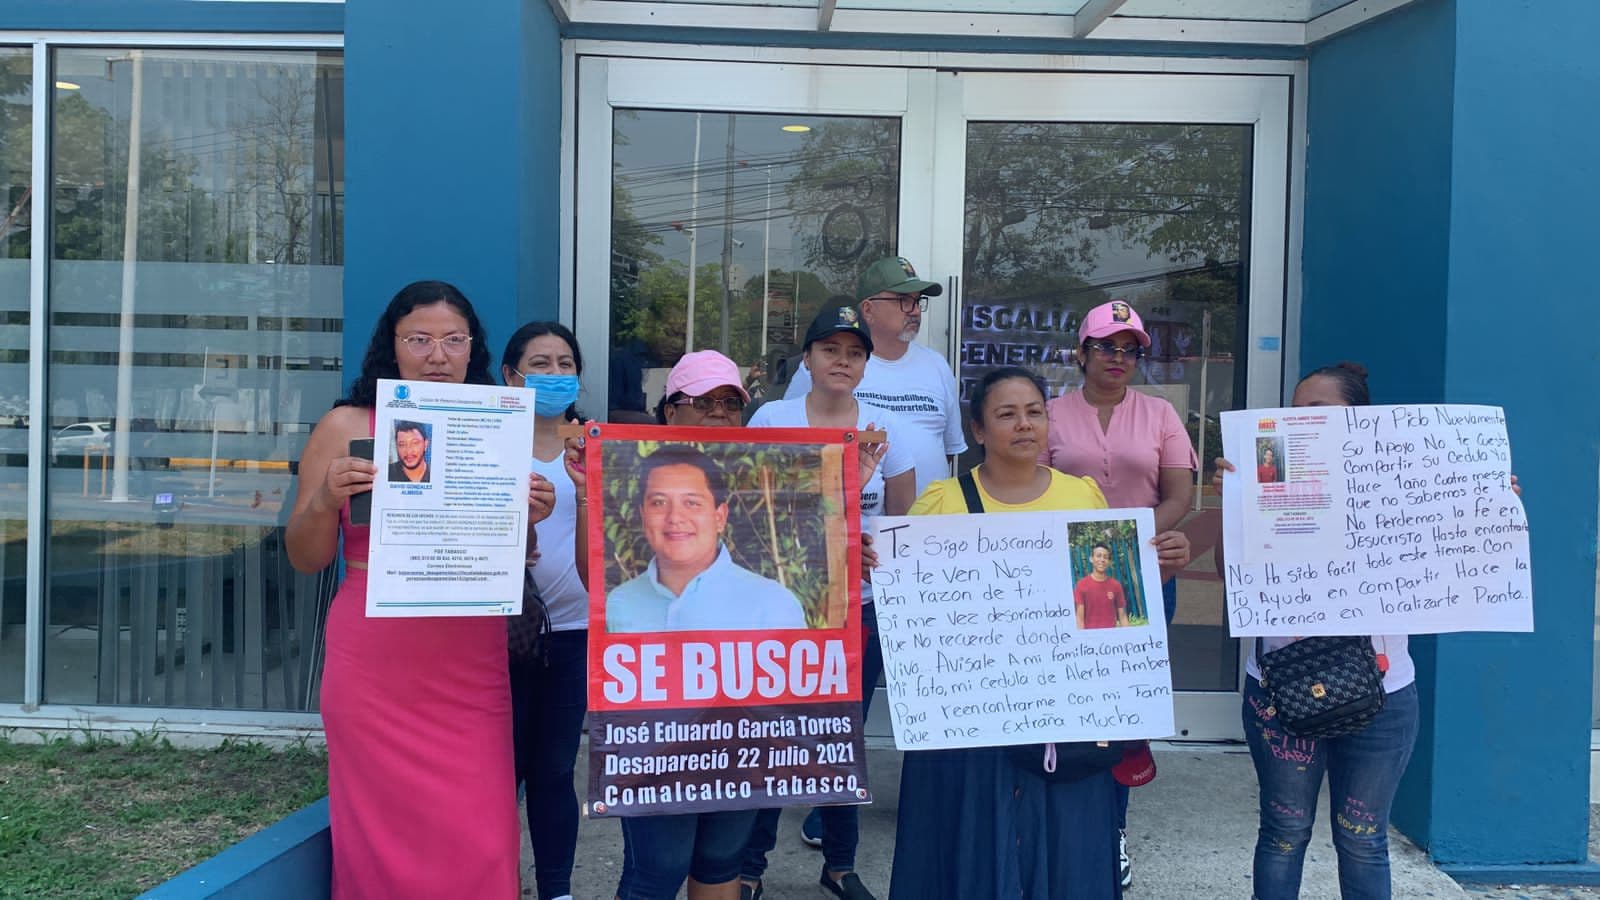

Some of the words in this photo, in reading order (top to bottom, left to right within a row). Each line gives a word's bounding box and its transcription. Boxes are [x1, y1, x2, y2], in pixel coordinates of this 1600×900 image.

[1345, 407, 1380, 436] Hoy
[1342, 441, 1364, 458] Su
[1424, 433, 1446, 450] No
[1456, 428, 1468, 446] te
[1346, 498, 1371, 512] que
[1382, 496, 1399, 506] no
[1473, 481, 1489, 496] de
[1347, 478, 1382, 494] Hace
[1346, 512, 1366, 531] No
[1452, 505, 1464, 519] la
[1499, 506, 1519, 517] en
[880, 524, 910, 559] Te
[977, 527, 1053, 553] buscando
[1433, 524, 1467, 542] Hasta
[872, 568, 900, 586] Si
[912, 560, 934, 584] te
[993, 559, 1033, 578] Nos
[1229, 563, 1254, 587] No
[1367, 552, 1392, 569] todo
[1399, 546, 1428, 562] este
[1482, 538, 1512, 554] Con
[879, 588, 906, 606] den
[919, 588, 971, 601] razon
[983, 584, 1004, 600] de
[1229, 590, 1248, 607] Tu
[1260, 587, 1311, 610] Ayuda
[1327, 588, 1348, 599] en
[1456, 560, 1500, 579] Hace
[1515, 557, 1528, 570] la
[878, 611, 898, 631] Si
[907, 616, 936, 628] me
[988, 602, 1071, 624] desorientado
[1233, 606, 1326, 628] Diferencia
[1340, 607, 1363, 619] en
[914, 632, 931, 648] No
[939, 627, 1003, 646] recuerde
[1016, 624, 1071, 646] donde
[603, 643, 667, 704] SE
[682, 640, 848, 700] BUSCA
[936, 650, 995, 673] Avisale
[1037, 671, 1056, 685] de
[1066, 659, 1110, 681] Alerta
[1121, 656, 1169, 673] Amber
[894, 702, 927, 726] Para
[1102, 690, 1121, 702] mi
[604, 721, 650, 745] José
[654, 718, 733, 743] Eduardo
[737, 715, 796, 739] García
[797, 715, 851, 736] Torres
[944, 726, 980, 739] me
[605, 749, 729, 776] Desapareció
[737, 747, 760, 769] 22
[767, 745, 810, 769] julio
[816, 742, 855, 765] 2021
[605, 777, 752, 808] Comalcalco
[764, 774, 859, 797] Tabasco
